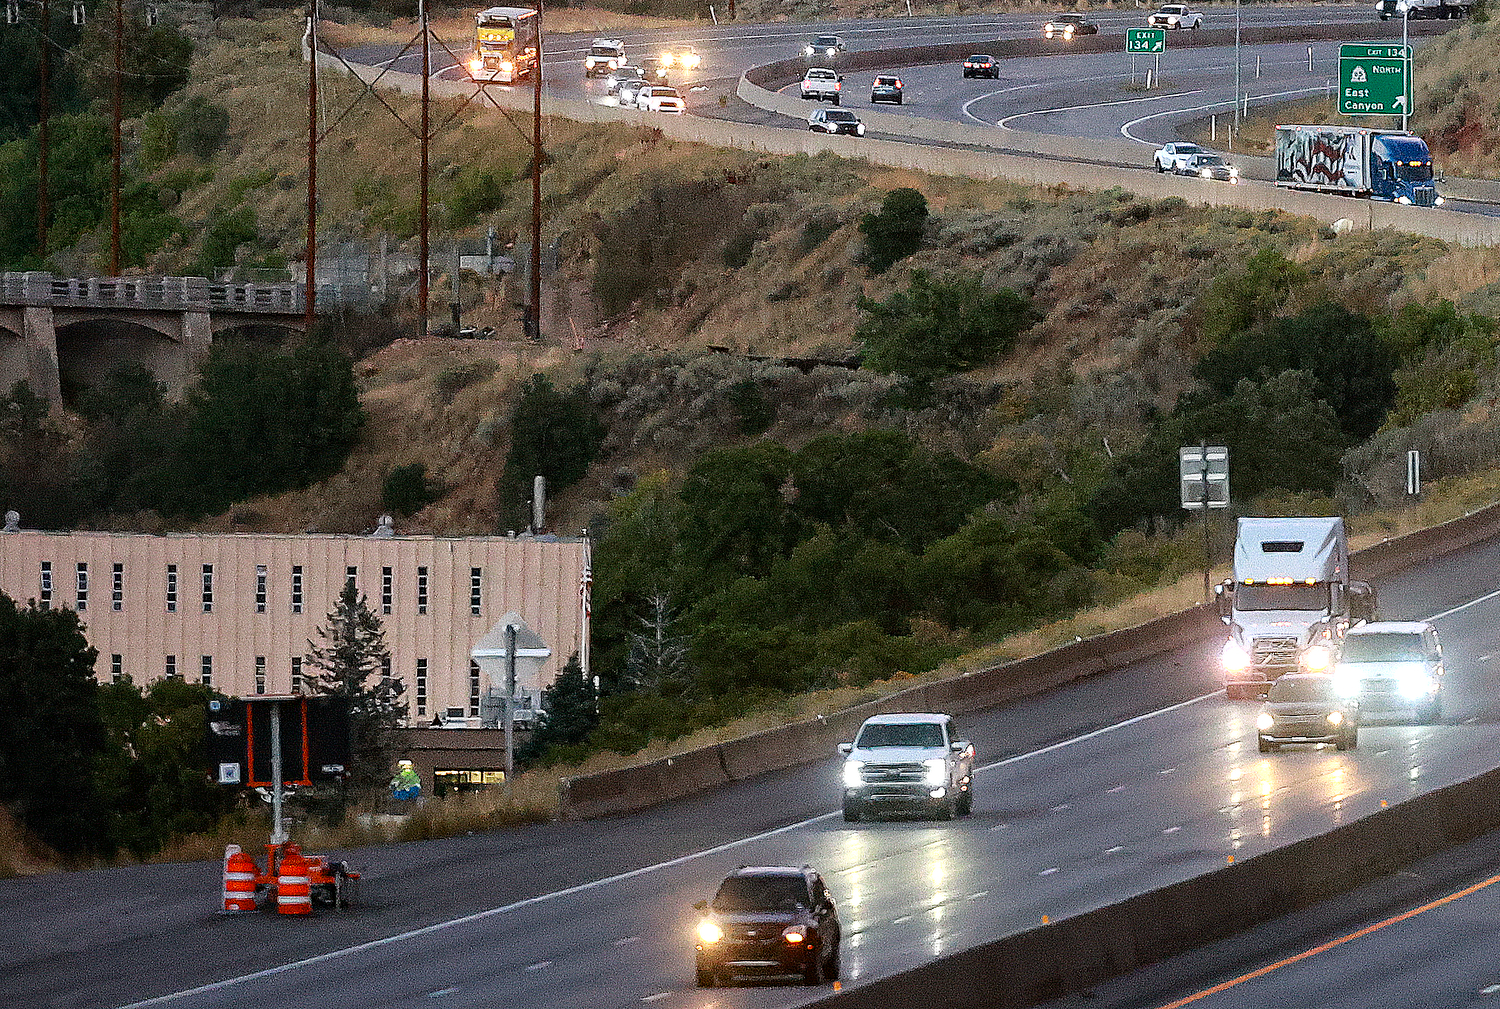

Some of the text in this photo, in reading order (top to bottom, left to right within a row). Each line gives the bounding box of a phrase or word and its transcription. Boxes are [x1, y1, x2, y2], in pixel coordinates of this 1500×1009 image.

[1129, 40, 1149, 50] 134
[1387, 48, 1406, 58] 134
[1372, 65, 1402, 74] NORTH
[1345, 88, 1370, 98] East
[1344, 100, 1384, 112] Canyon
